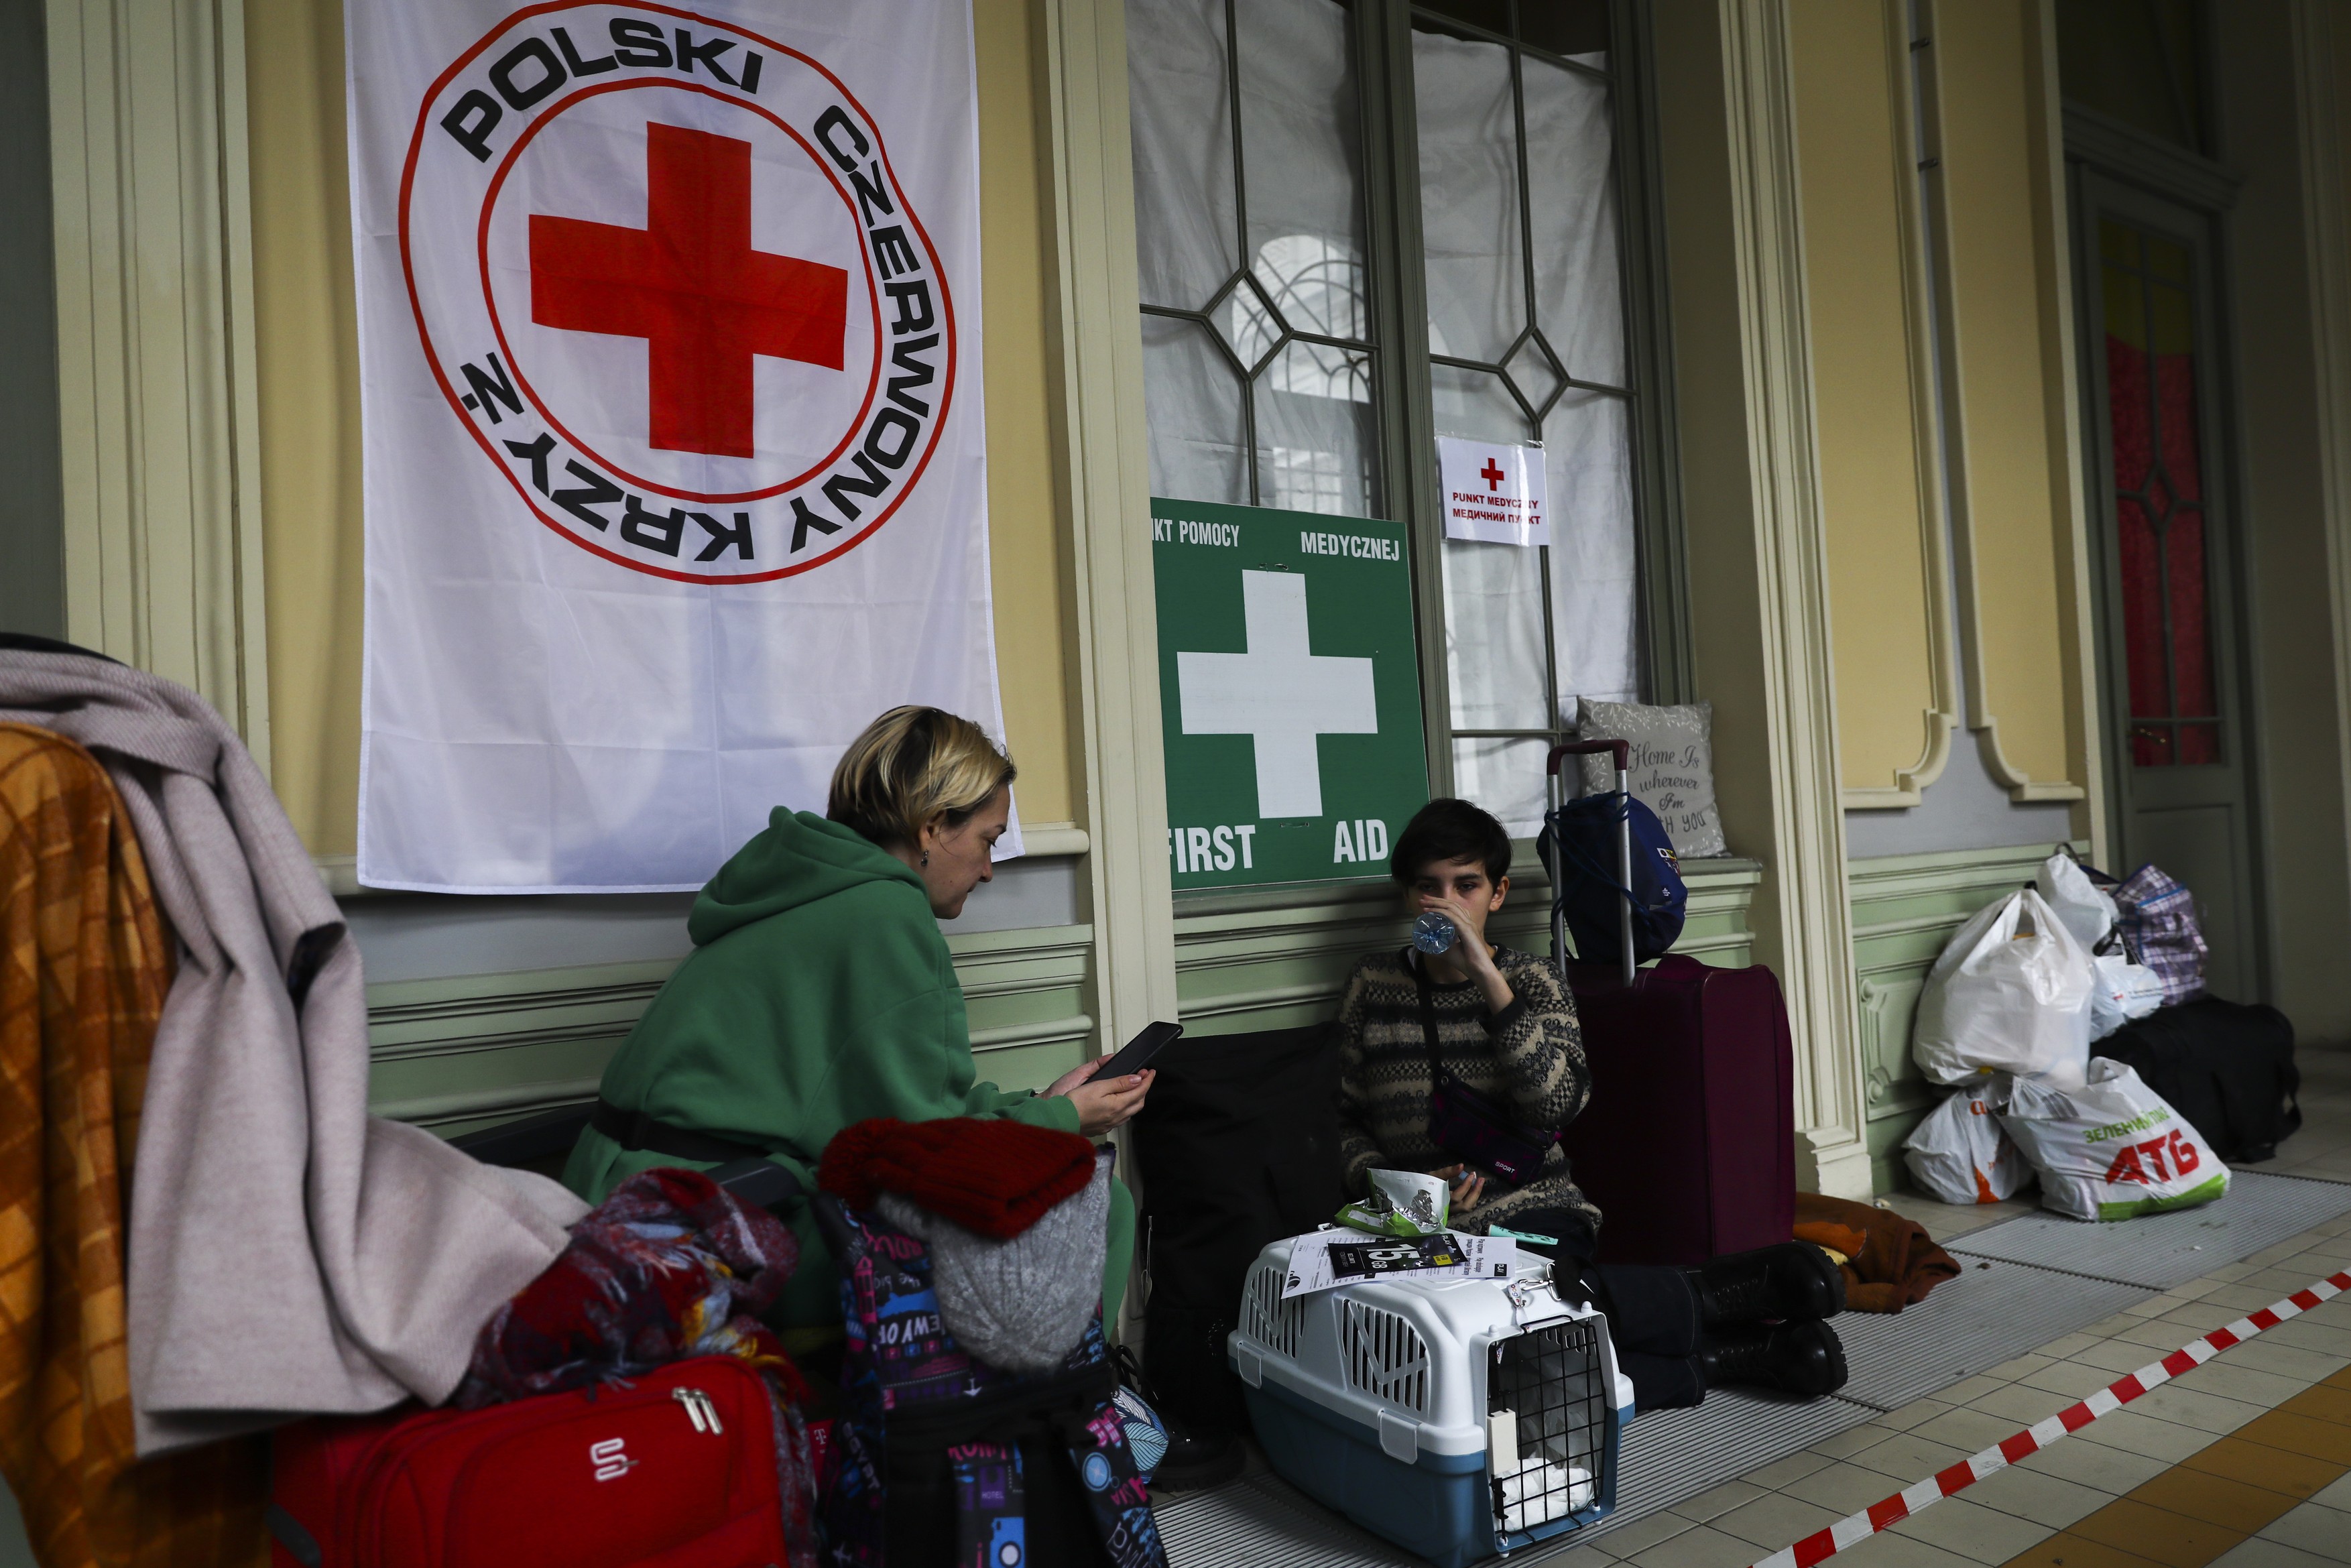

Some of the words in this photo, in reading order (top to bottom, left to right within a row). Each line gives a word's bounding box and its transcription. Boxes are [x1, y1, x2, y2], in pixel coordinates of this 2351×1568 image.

[440, 18, 764, 163] POLSKI
[790, 105, 940, 554] CZERWONY
[461, 353, 754, 562] KRZYŻ
[1453, 492, 1484, 503] PUNKT
[1488, 496, 1539, 509] MEDYCZY
[1453, 508, 1505, 522] МЕДИЧНИЙ
[1508, 514, 1541, 524] ПУКТ
[1179, 520, 1240, 547] POMOCY
[1301, 532, 1400, 561] MEDYCZNEJ
[1629, 741, 1675, 773] Home
[1679, 745, 1700, 769] Is
[1640, 770, 1700, 792] wherever
[1333, 819, 1388, 863] AID
[1494, 1161, 1516, 1174] SPORT
[1441, 1235, 1452, 1246] PLAY
[1370, 1260, 1388, 1269] GB
[981, 1491, 1004, 1499] HOTEL
